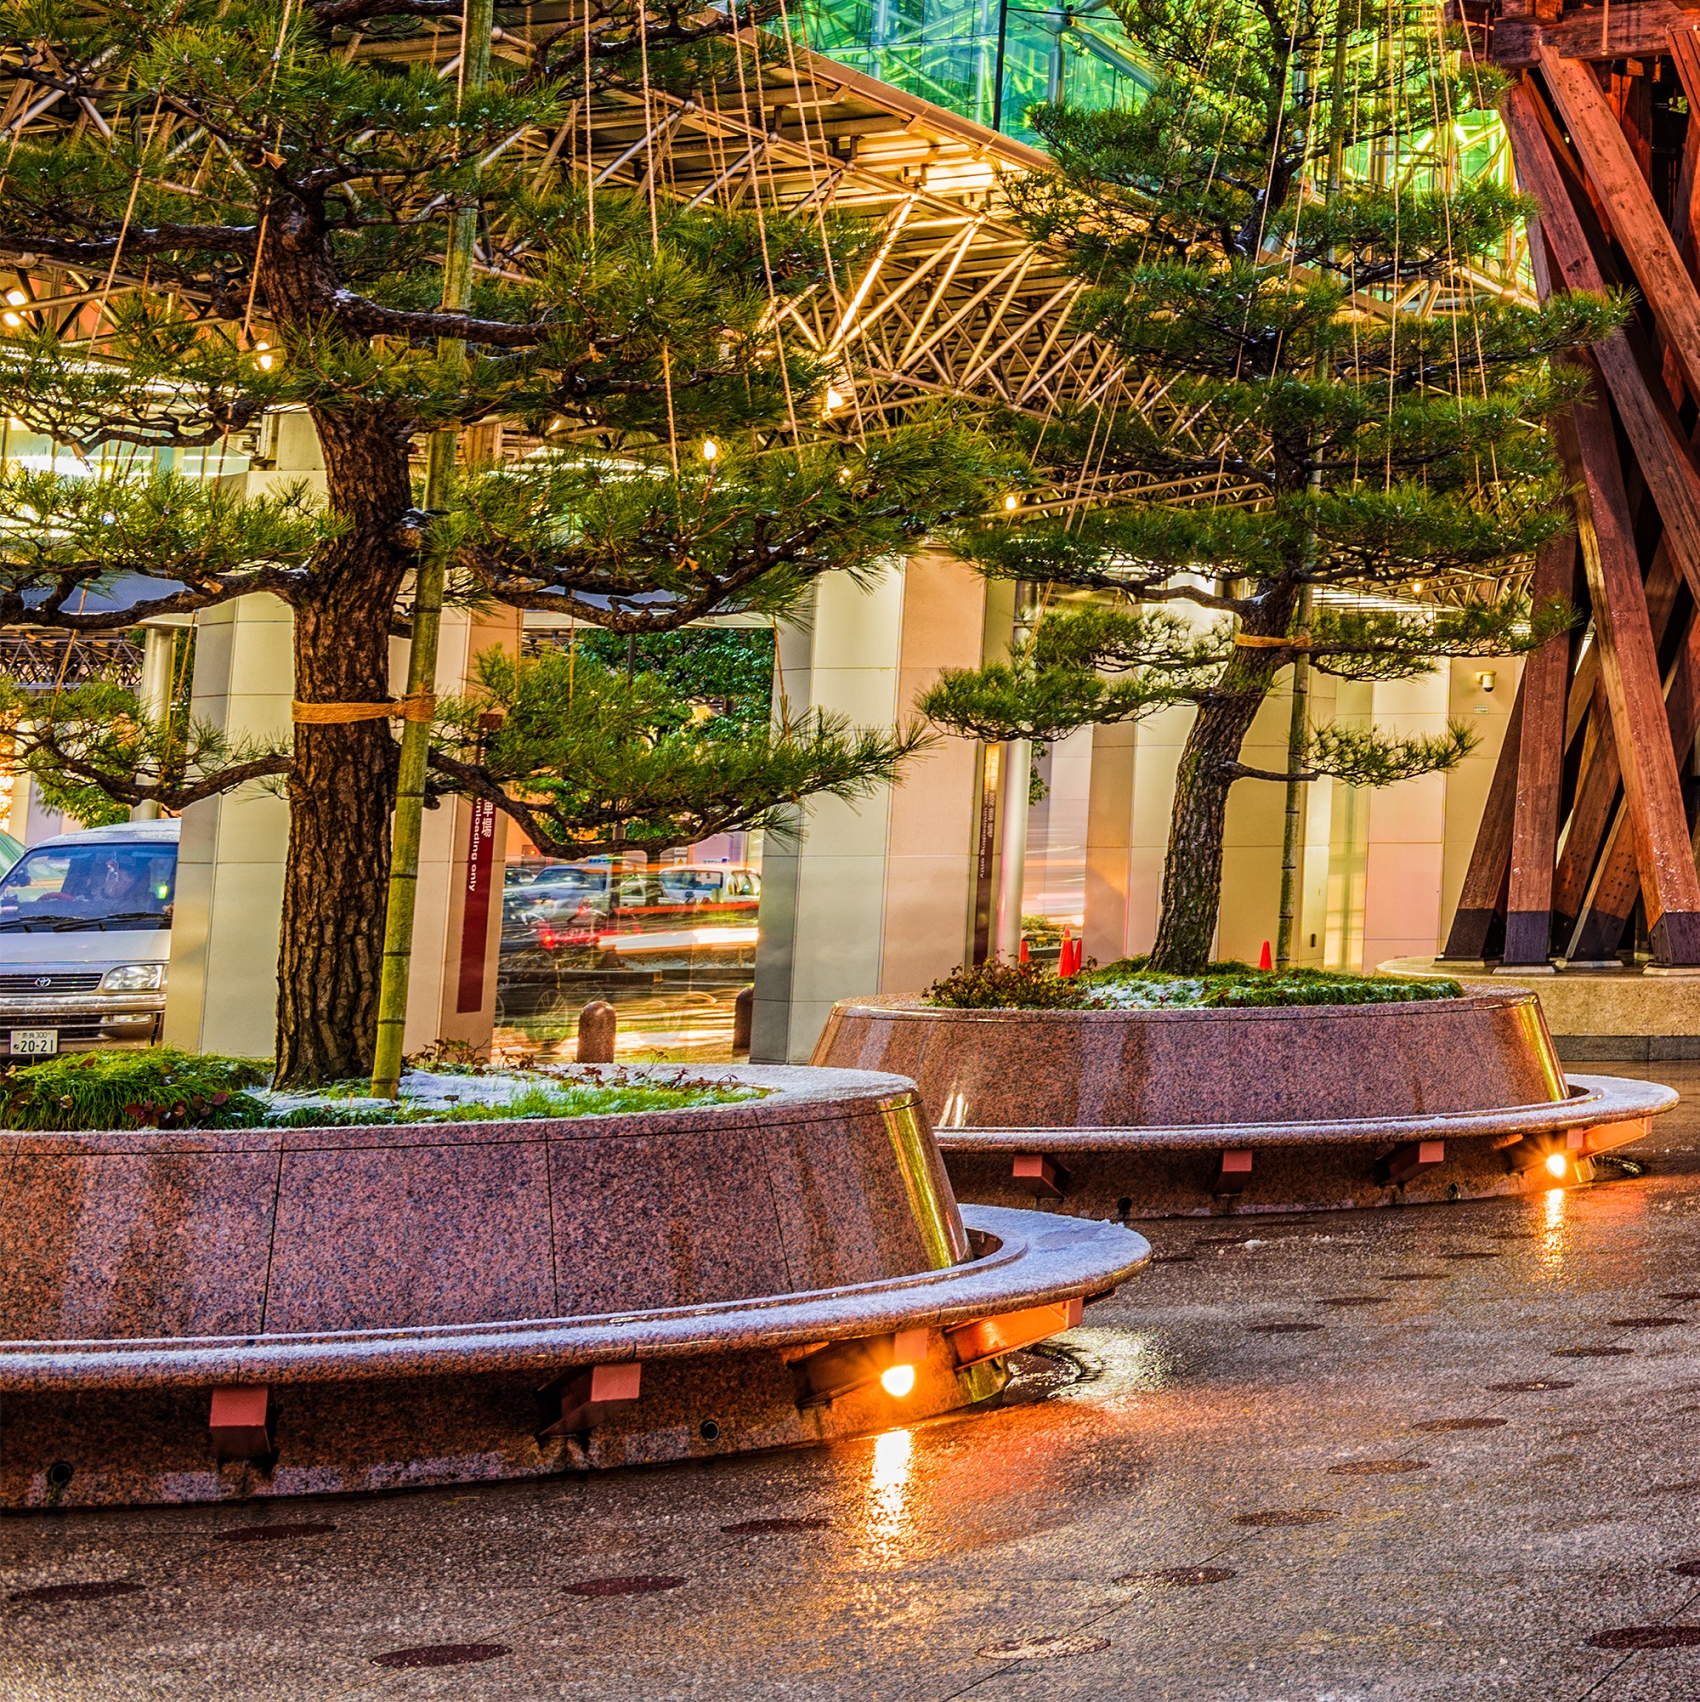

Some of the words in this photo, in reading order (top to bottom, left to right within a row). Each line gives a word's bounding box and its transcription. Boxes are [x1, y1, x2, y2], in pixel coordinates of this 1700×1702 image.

[471, 797, 482, 861] unloading
[468, 863, 478, 892] only
[20, 1039, 54, 1053] 20-21
